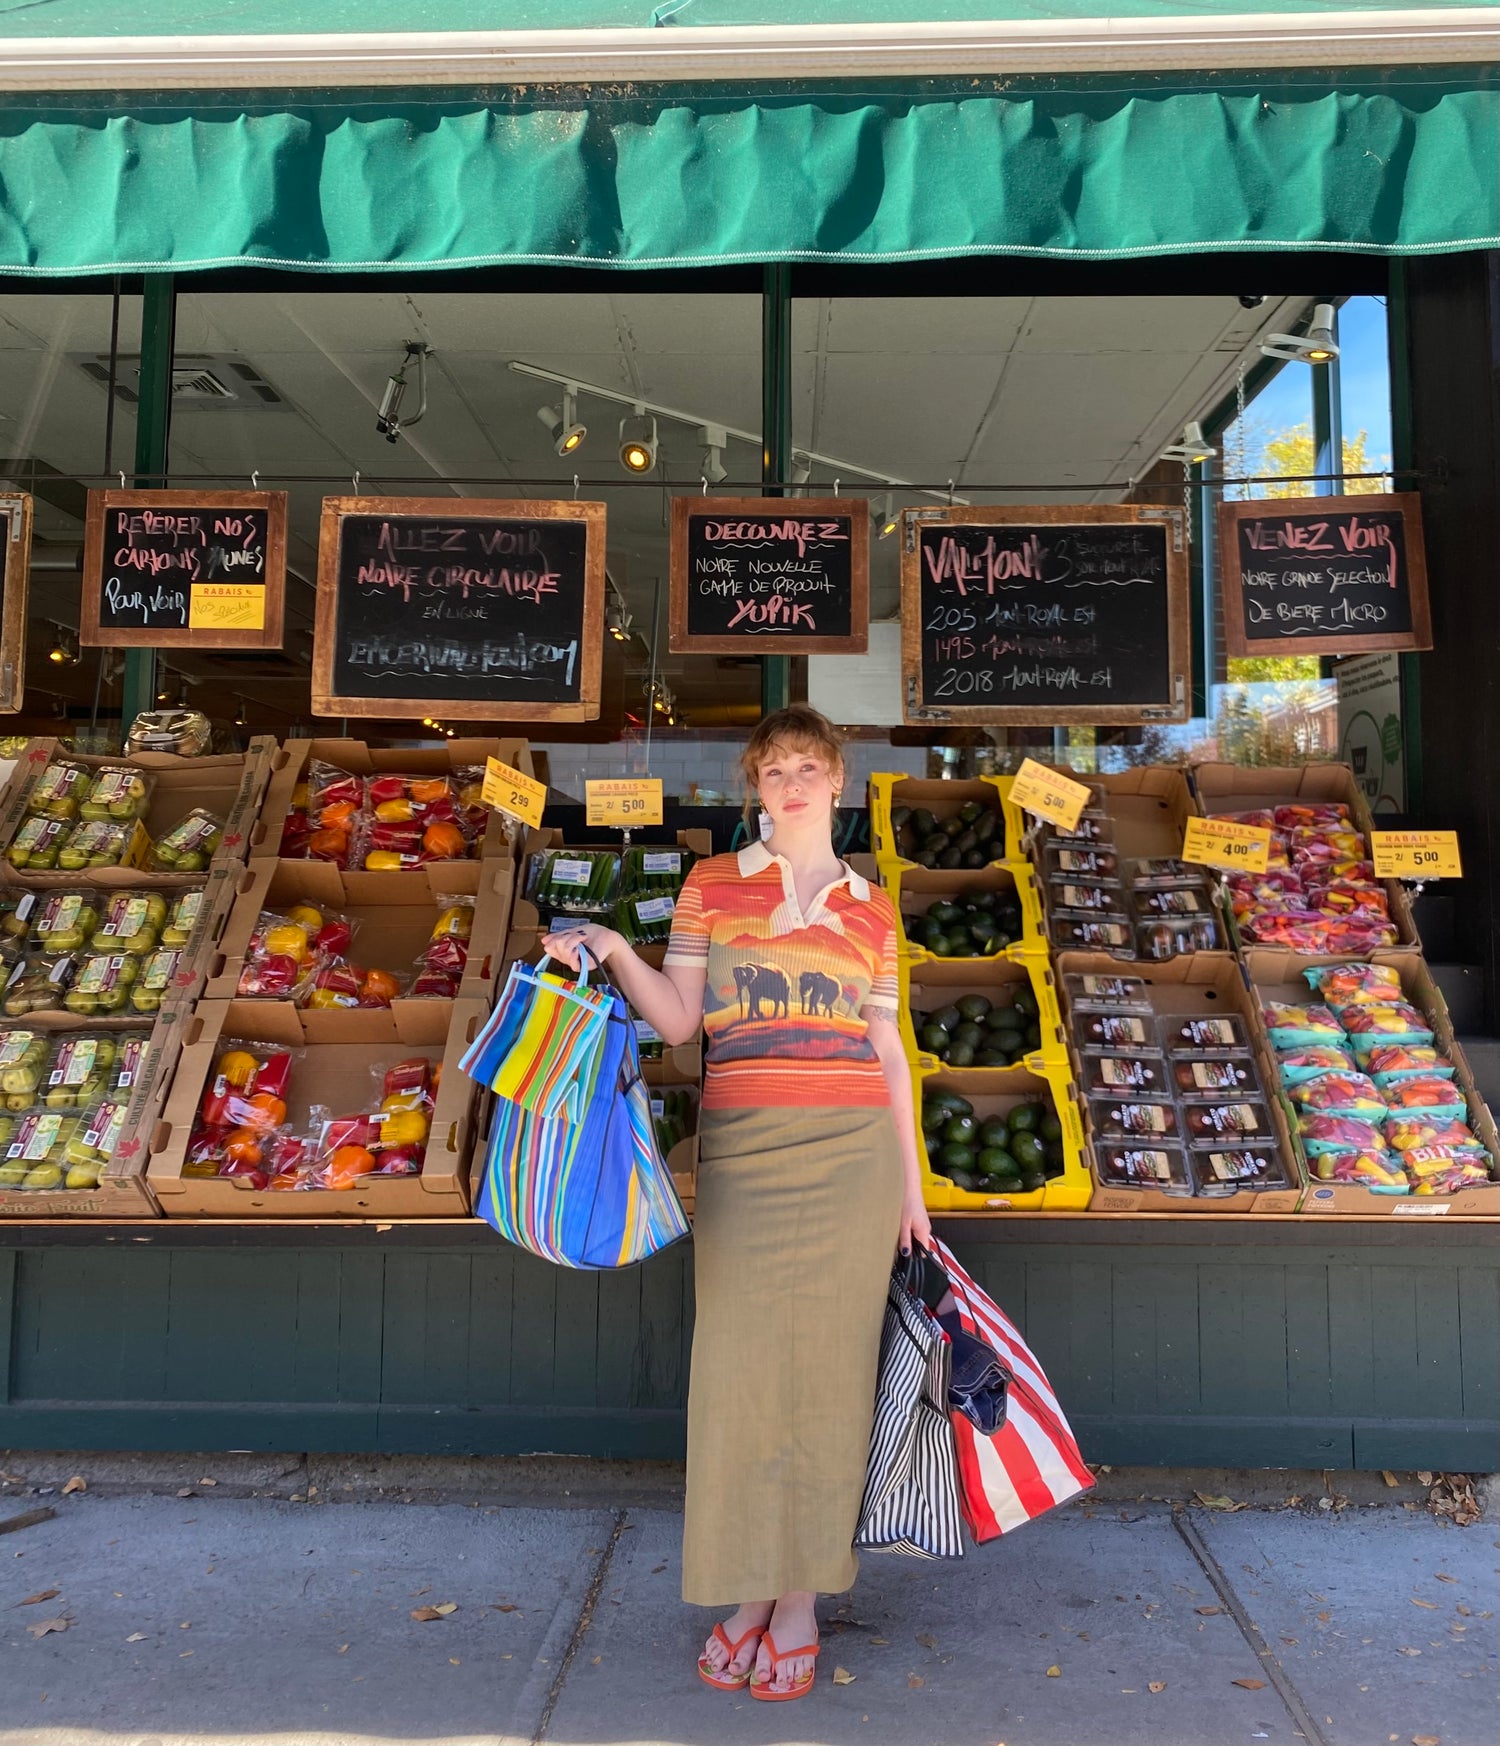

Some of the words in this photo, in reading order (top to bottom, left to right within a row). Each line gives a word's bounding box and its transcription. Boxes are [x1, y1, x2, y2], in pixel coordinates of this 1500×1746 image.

[213, 515, 257, 549] NOS
[704, 519, 850, 559] DECOUVREZ
[1244, 521, 1335, 551] VENEZ
[377, 522, 467, 563] ALLEZ
[478, 528, 550, 575] VOIR
[748, 558, 824, 576] NOUVELLE
[203, 587, 243, 596] RABAIS
[749, 579, 772, 594] DE
[421, 601, 444, 621] EN
[445, 605, 489, 621] LIGNE
[925, 605, 978, 632] 205
[1248, 598, 1274, 623] DE
[1276, 602, 1325, 625] BIERE
[1330, 597, 1388, 623] MICRO
[934, 635, 977, 663] 1495
[934, 667, 995, 697] 2018
[598, 782, 640, 792] RABAIS
[1200, 821, 1245, 836] RABAIS
[1385, 834, 1430, 843] RABAIS
